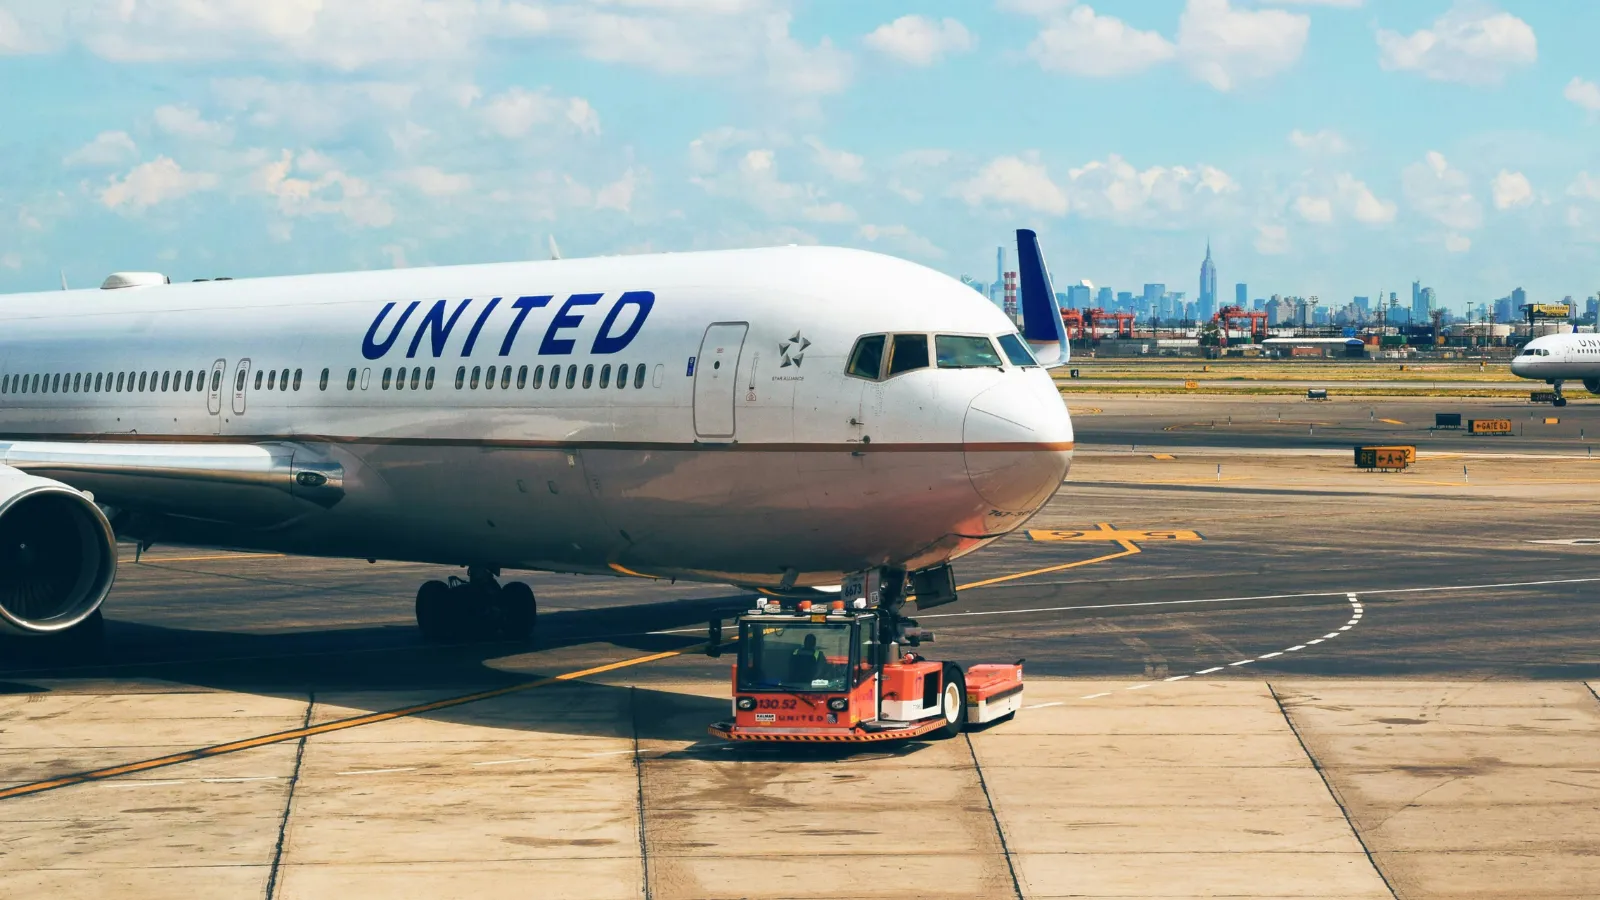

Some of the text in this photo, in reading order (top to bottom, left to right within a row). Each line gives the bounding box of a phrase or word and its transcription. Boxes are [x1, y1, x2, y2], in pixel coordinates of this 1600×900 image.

[361, 290, 656, 360] UNITED
[1482, 422, 1507, 430] GATE 63
[1387, 453, 1394, 464] A
[844, 583, 862, 597] 6673
